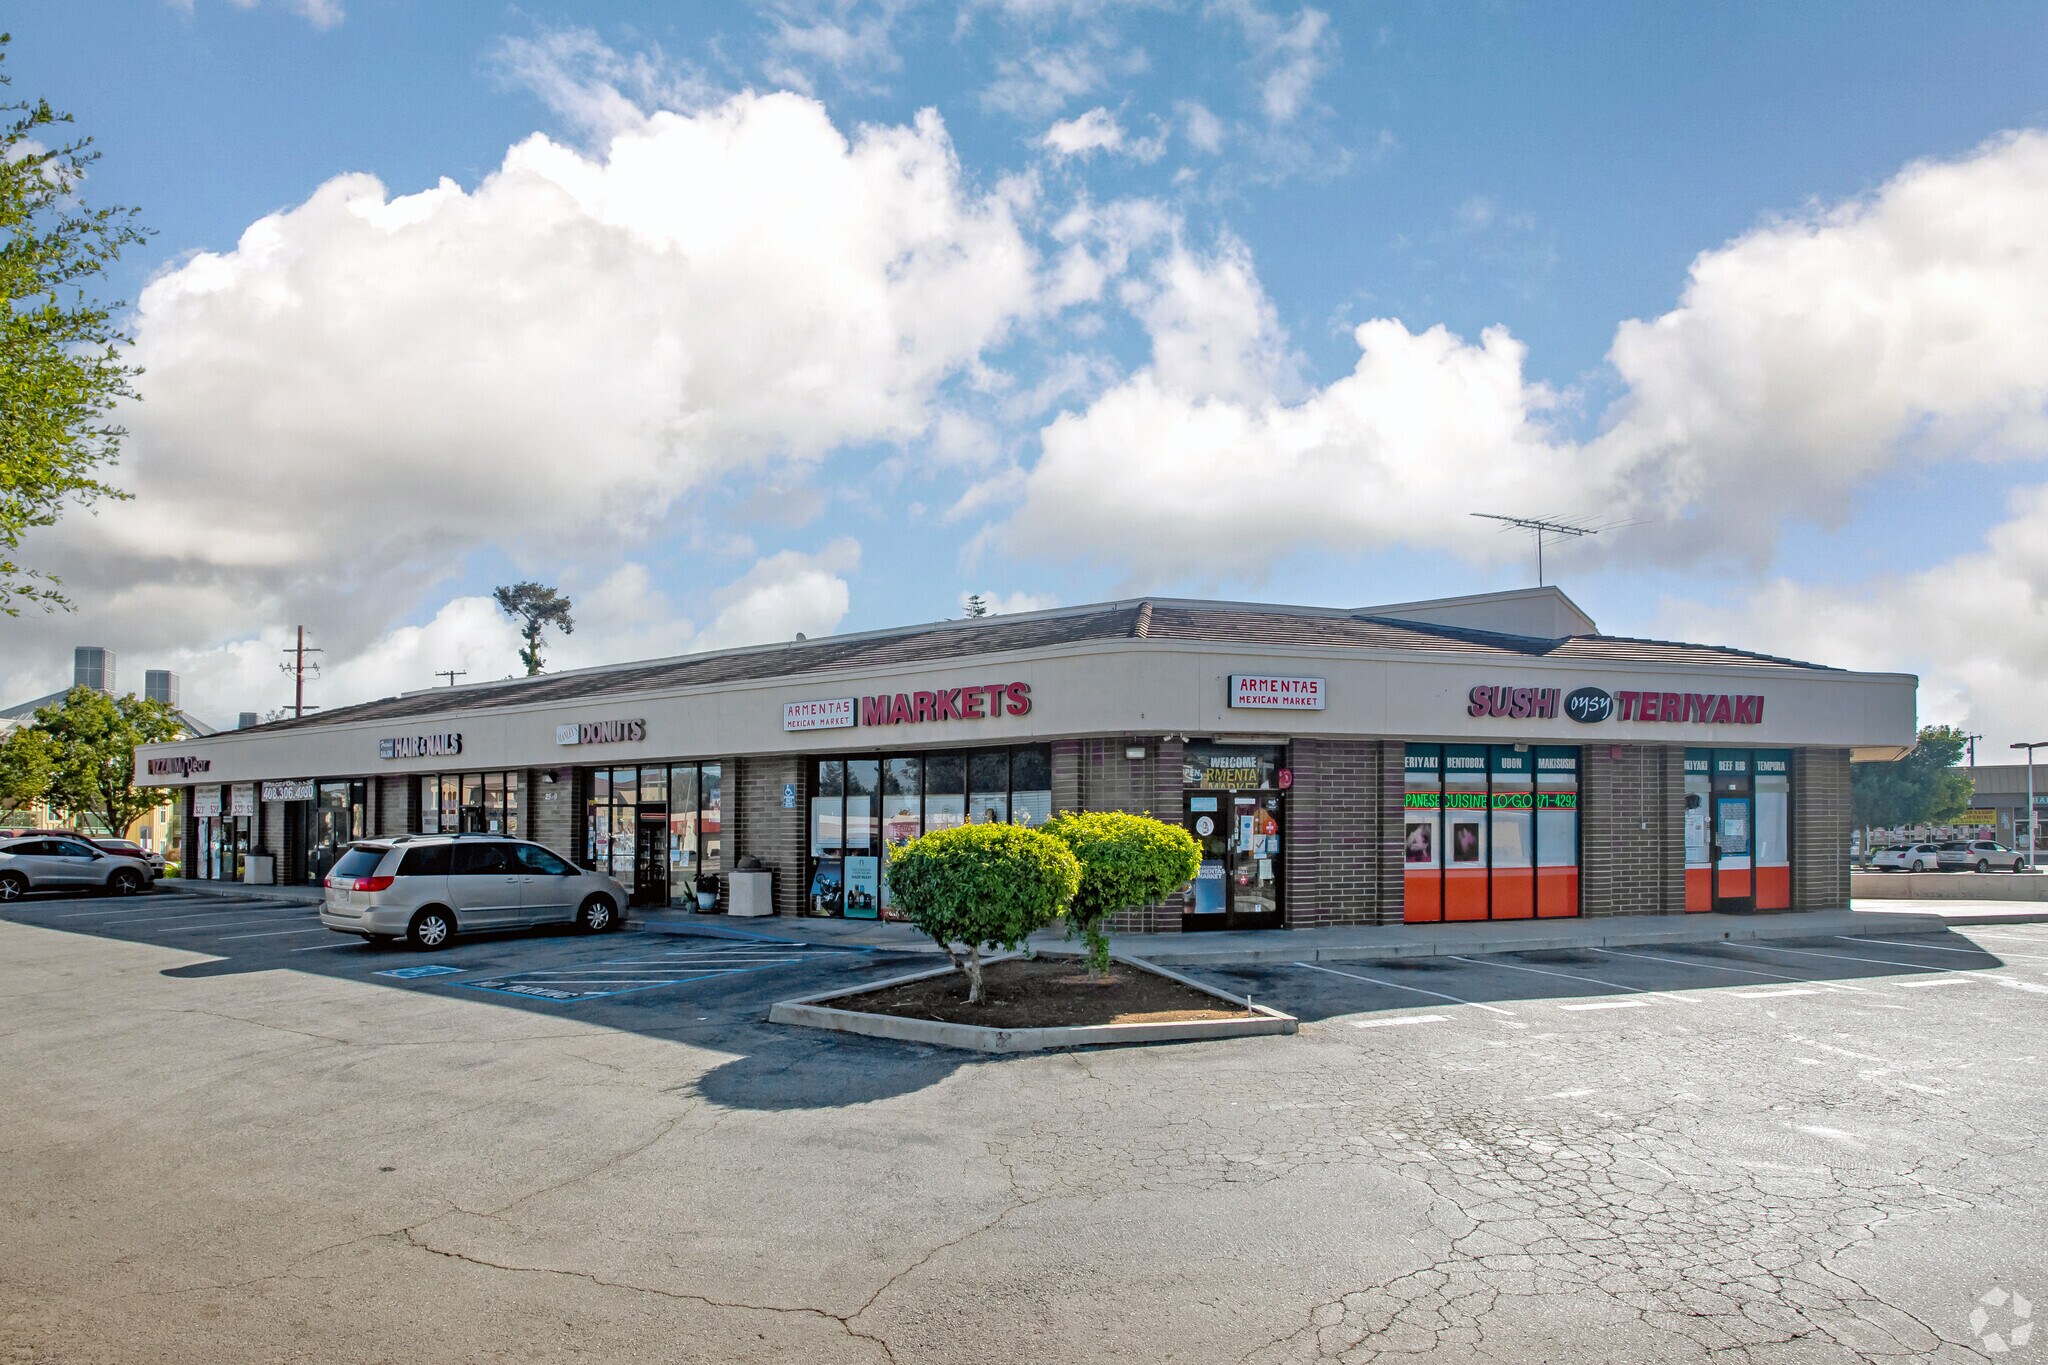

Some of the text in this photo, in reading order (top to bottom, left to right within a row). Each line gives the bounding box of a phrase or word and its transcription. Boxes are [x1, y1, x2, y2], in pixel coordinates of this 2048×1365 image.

[1240, 679, 1318, 693] ARMENTAS
[862, 682, 1031, 726] MARKETS
[1239, 696, 1317, 705] MEXICAN MARKET
[1467, 686, 1561, 718] SUSHI
[1615, 691, 1765, 723] TERIYAKI
[788, 701, 850, 716] ARMENTAS
[1571, 696, 1611, 720] oysy
[788, 717, 849, 728] MEXICAN MARKET
[580, 719, 646, 744] DONUTS
[394, 736, 420, 758] HAIR
[426, 733, 462, 756] NAILS
[1211, 757, 1257, 768] WELCOME
[1447, 757, 1484, 768] BENTOBOX
[1501, 758, 1522, 768] UDON
[1538, 758, 1575, 769] MAKISUSHI
[1757, 761, 1785, 771] TEMPURA
[1404, 794, 1440, 808] PANESE
[1445, 794, 1487, 808] CUISINE
